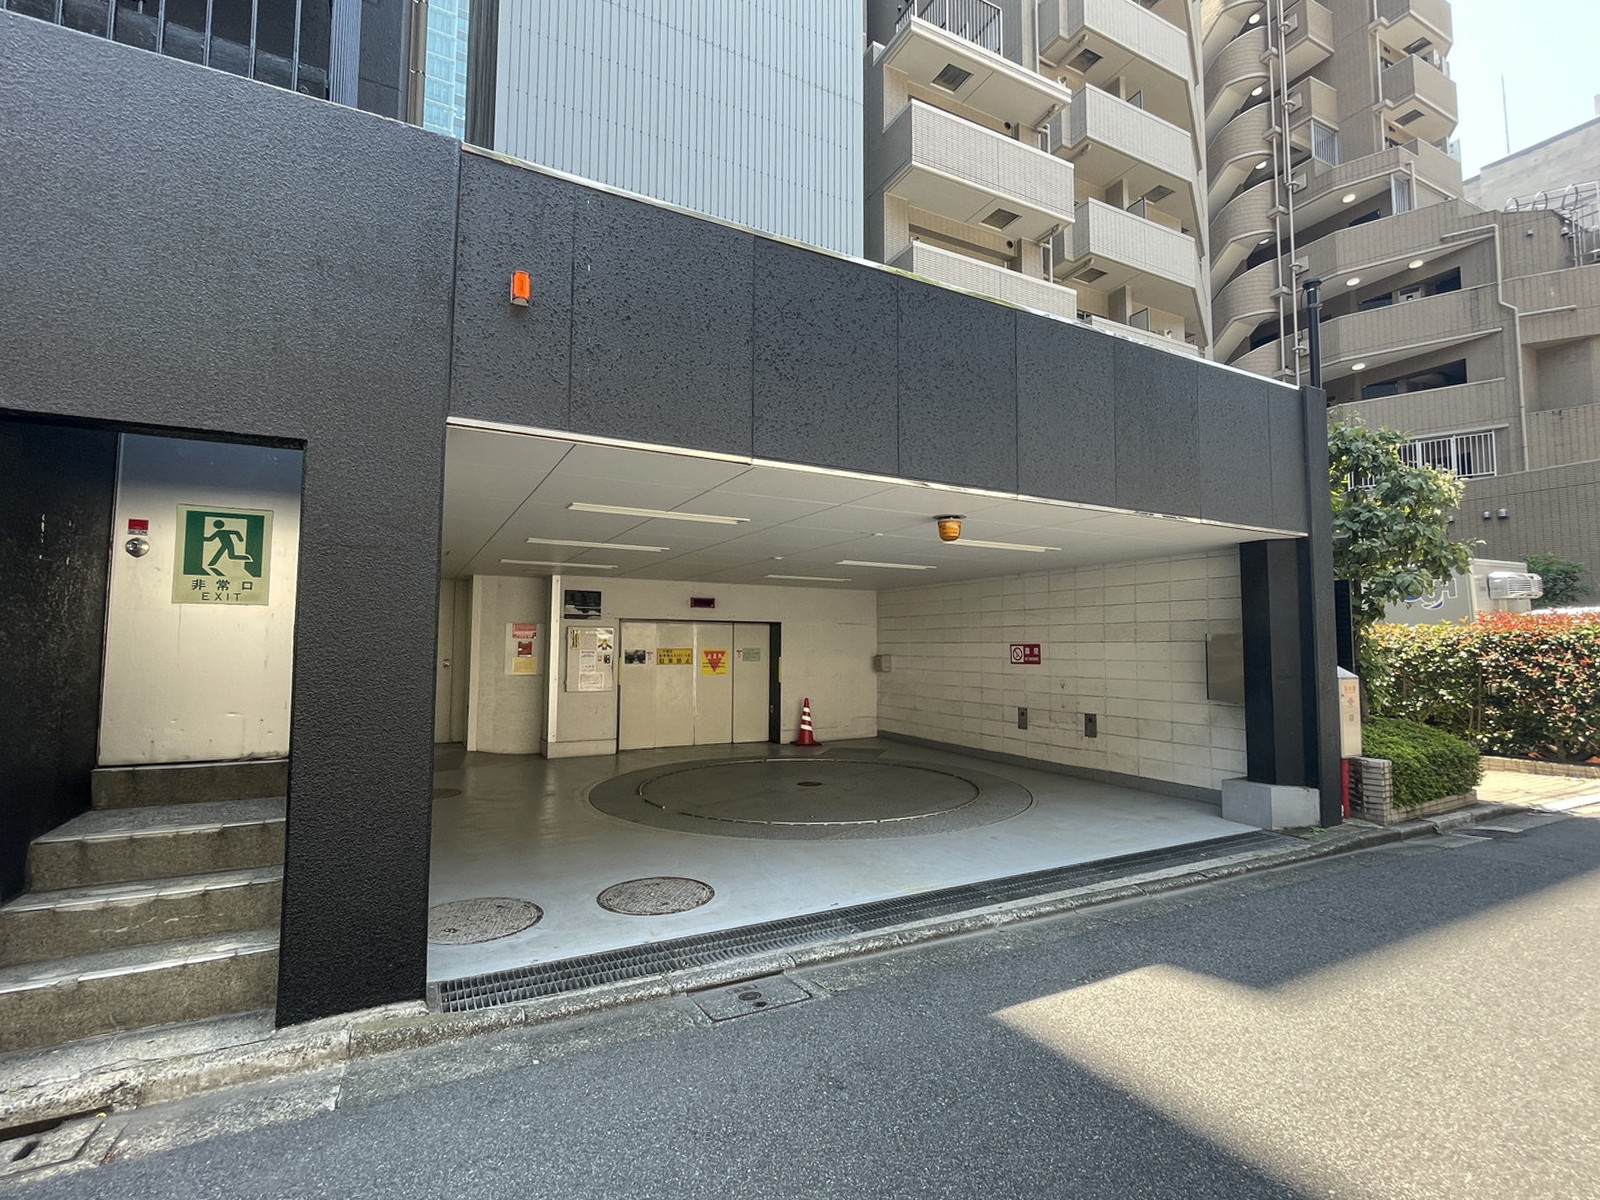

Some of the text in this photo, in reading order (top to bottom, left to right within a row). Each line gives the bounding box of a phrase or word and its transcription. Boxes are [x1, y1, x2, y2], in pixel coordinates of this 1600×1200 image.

[191, 579, 253, 591] 非常口
[202, 592, 242, 601] EXIT
